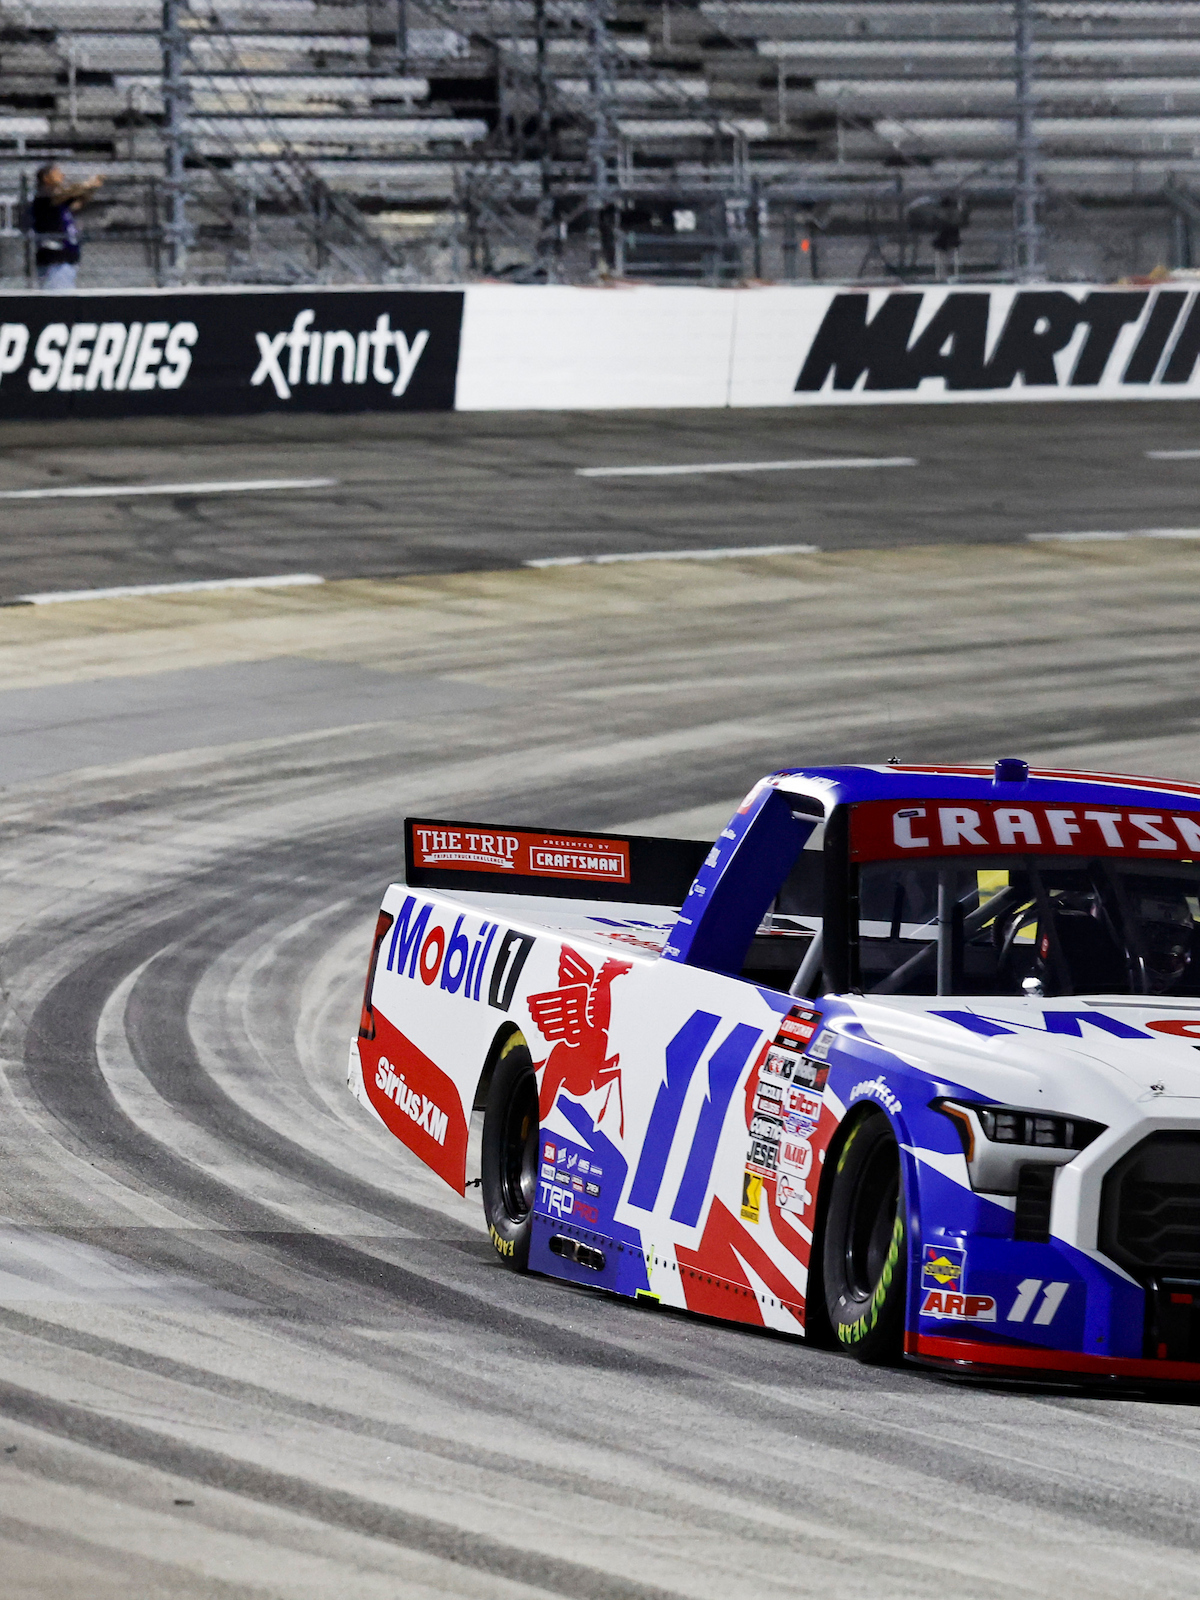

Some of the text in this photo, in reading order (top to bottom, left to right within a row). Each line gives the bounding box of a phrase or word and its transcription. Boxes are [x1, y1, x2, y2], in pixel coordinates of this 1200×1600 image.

[28, 321, 199, 392] SERIES
[250, 310, 430, 399] xfinity
[417, 830, 519, 858] THE TRIP
[536, 852, 619, 872] CRAFTSMAN
[543, 839, 594, 849] PRESENTED
[386, 895, 499, 1002] Mobil
[375, 1056, 449, 1147] SiriusXM
[628, 1009, 764, 1228] 11
[540, 1181, 575, 1218] TRD
[923, 1292, 994, 1317] ARP
[1006, 1278, 1070, 1326] 11
